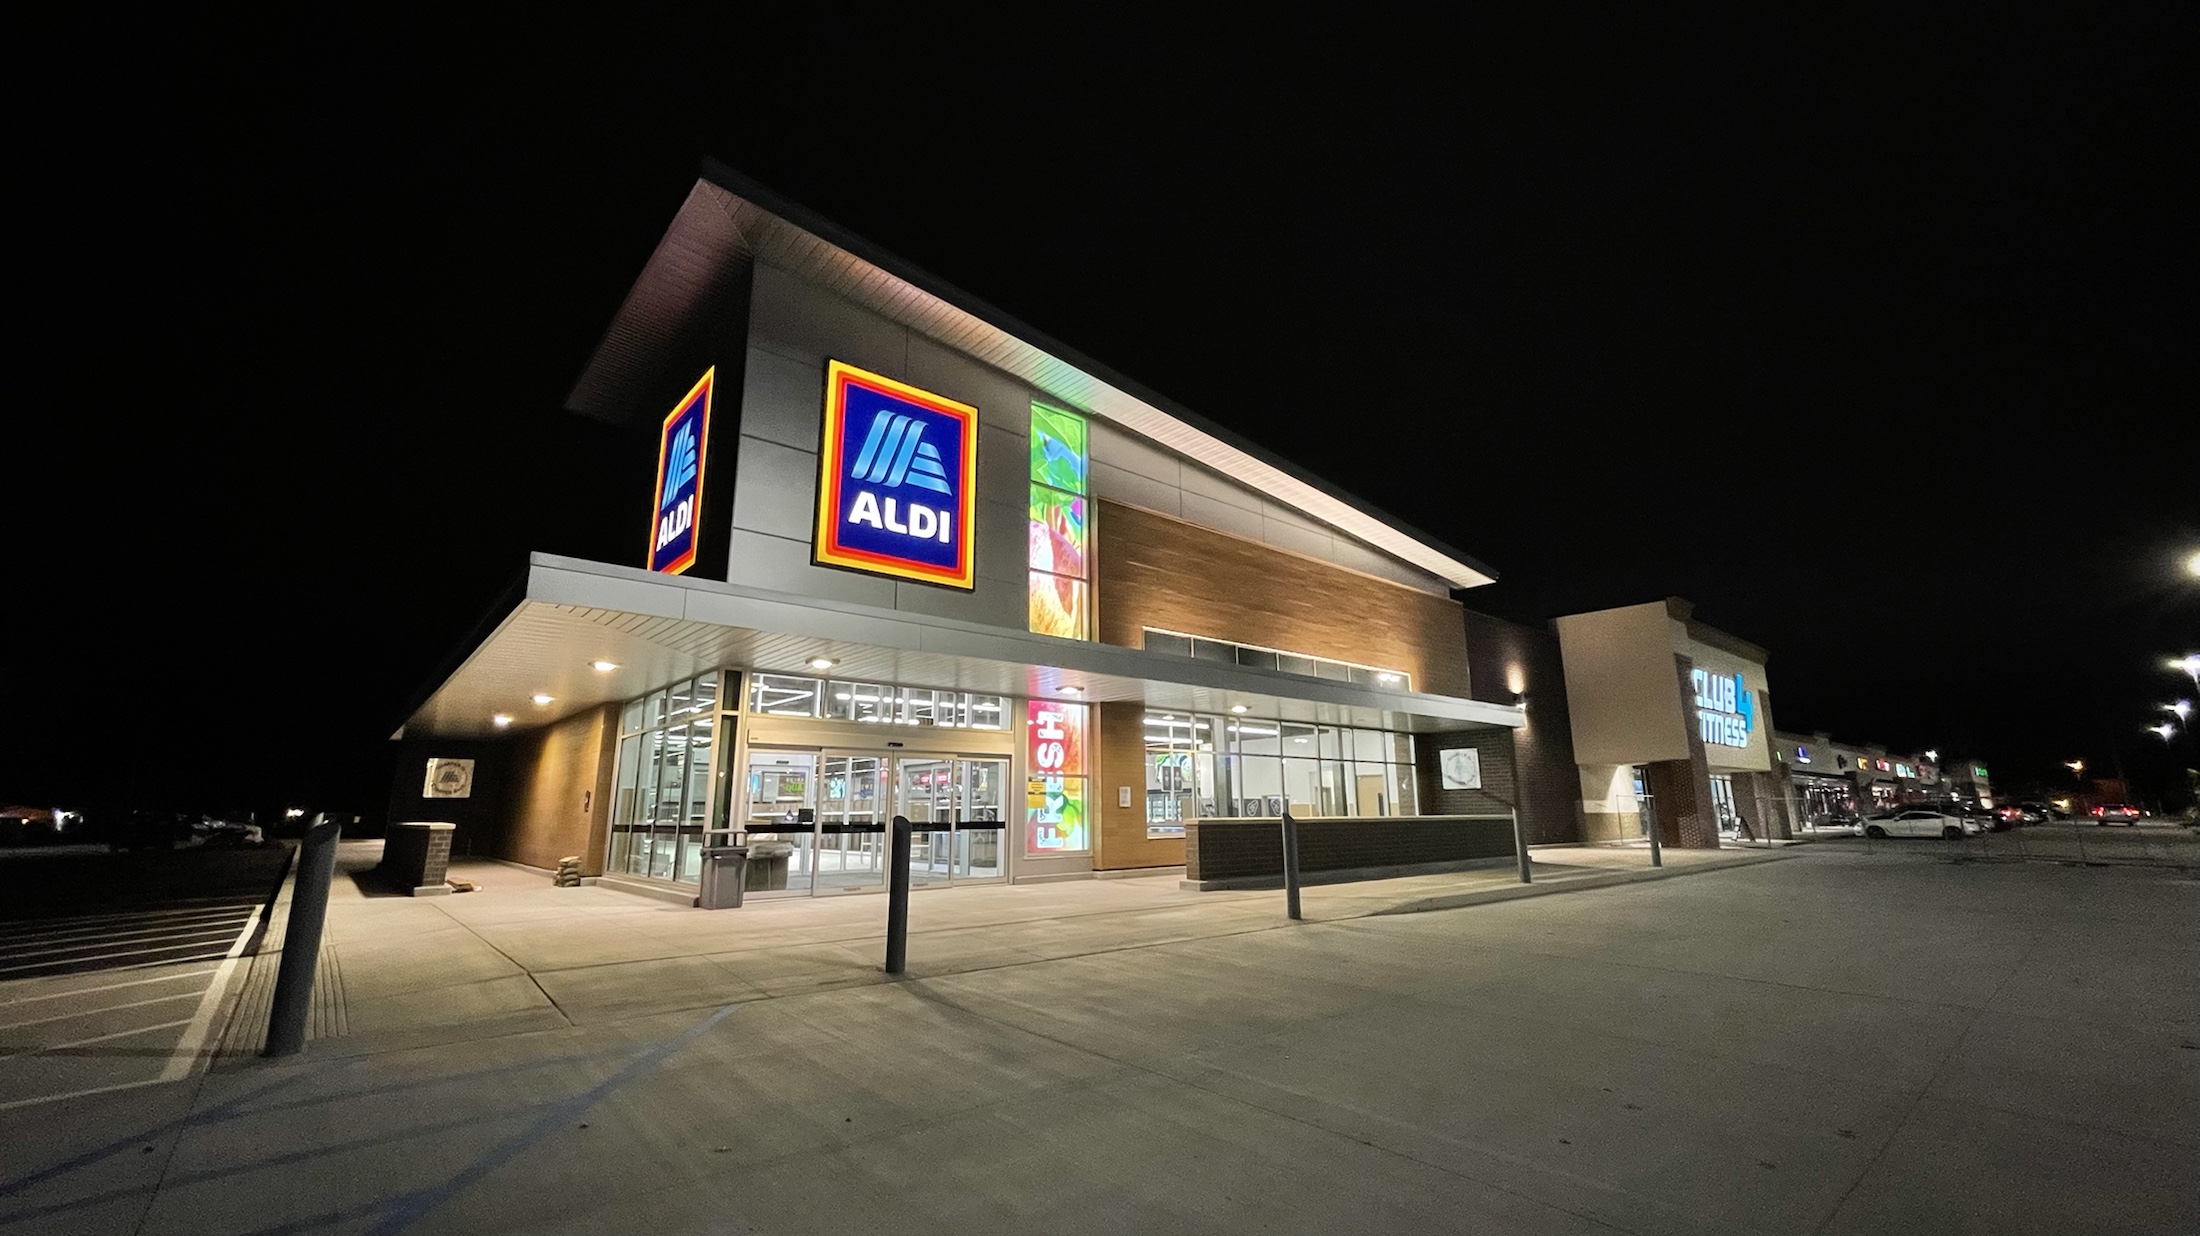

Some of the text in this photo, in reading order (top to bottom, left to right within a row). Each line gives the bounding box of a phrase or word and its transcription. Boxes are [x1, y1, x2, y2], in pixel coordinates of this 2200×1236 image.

[656, 494, 695, 552] ALDI
[848, 491, 951, 543] ALDI
[1691, 668, 1753, 733] CLUB 4
[1037, 711, 1064, 849] FRESH
